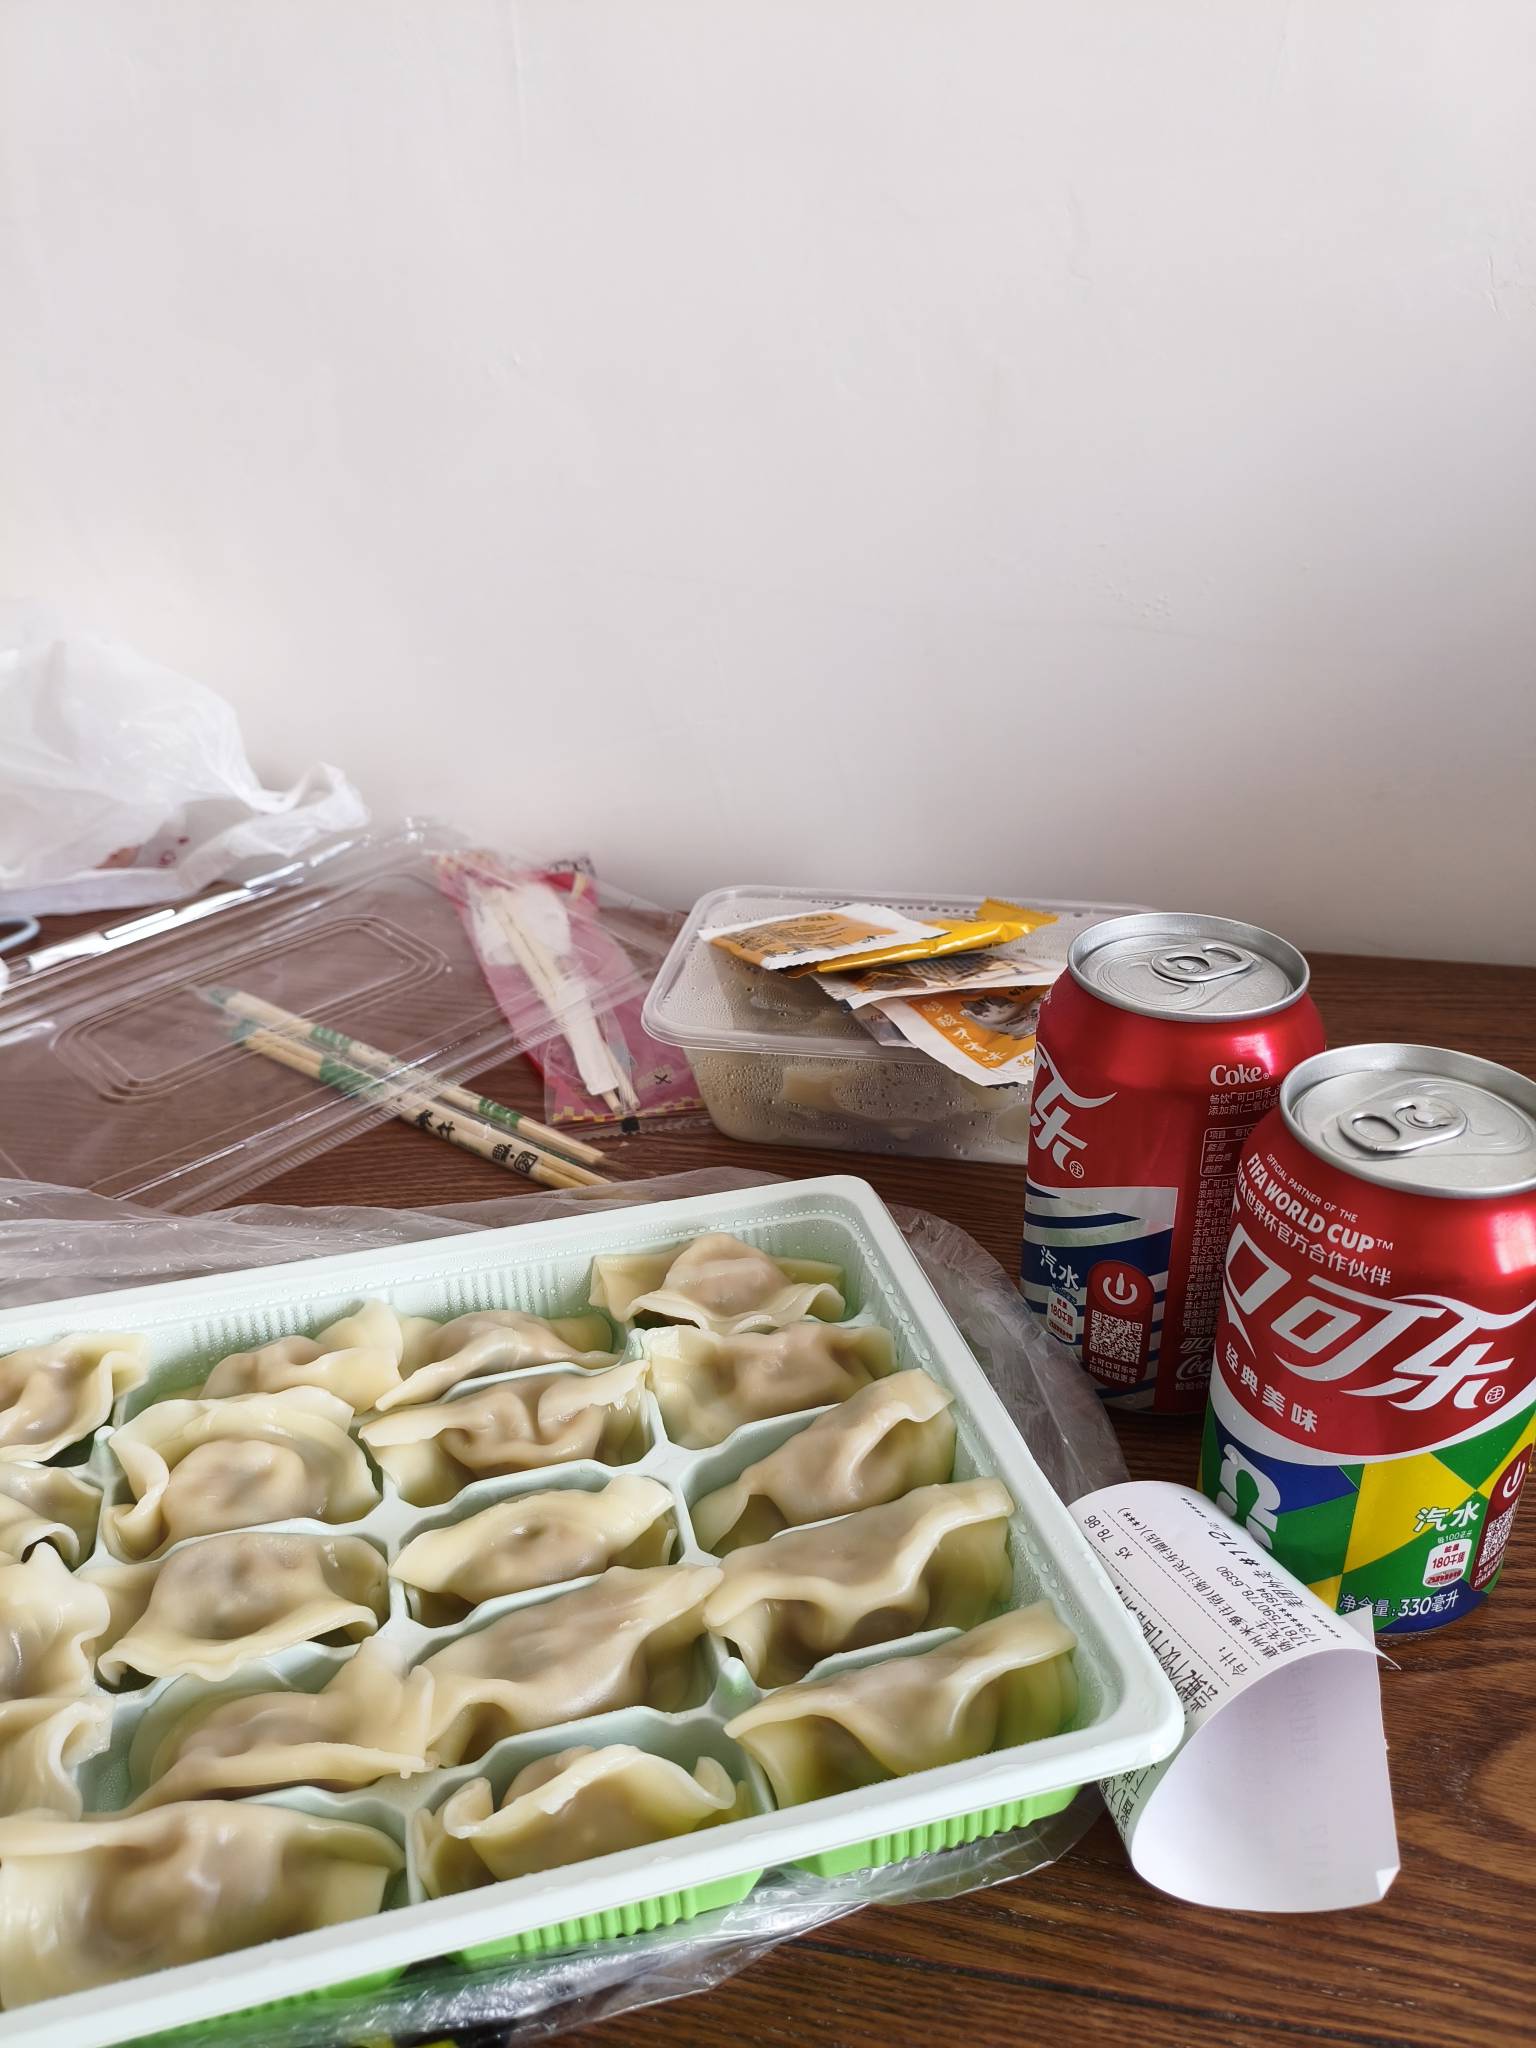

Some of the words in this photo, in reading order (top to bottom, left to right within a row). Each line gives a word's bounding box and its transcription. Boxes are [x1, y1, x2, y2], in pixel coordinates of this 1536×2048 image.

[1210, 1063, 1262, 1086] Coke
[1247, 1152, 1269, 1190] FIFA
[1264, 1179, 1326, 1234] WORLD
[1267, 1153, 1287, 1181] OFFICIAL
[1288, 1177, 1322, 1206] PARTNER
[1323, 1202, 1337, 1213] OF
[1340, 1208, 1358, 1223] THE
[1040, 1245, 1080, 1290] 汽水
[1225, 1341, 1318, 1433] 经典美味
[1412, 1501, 1480, 1533] 汽水
